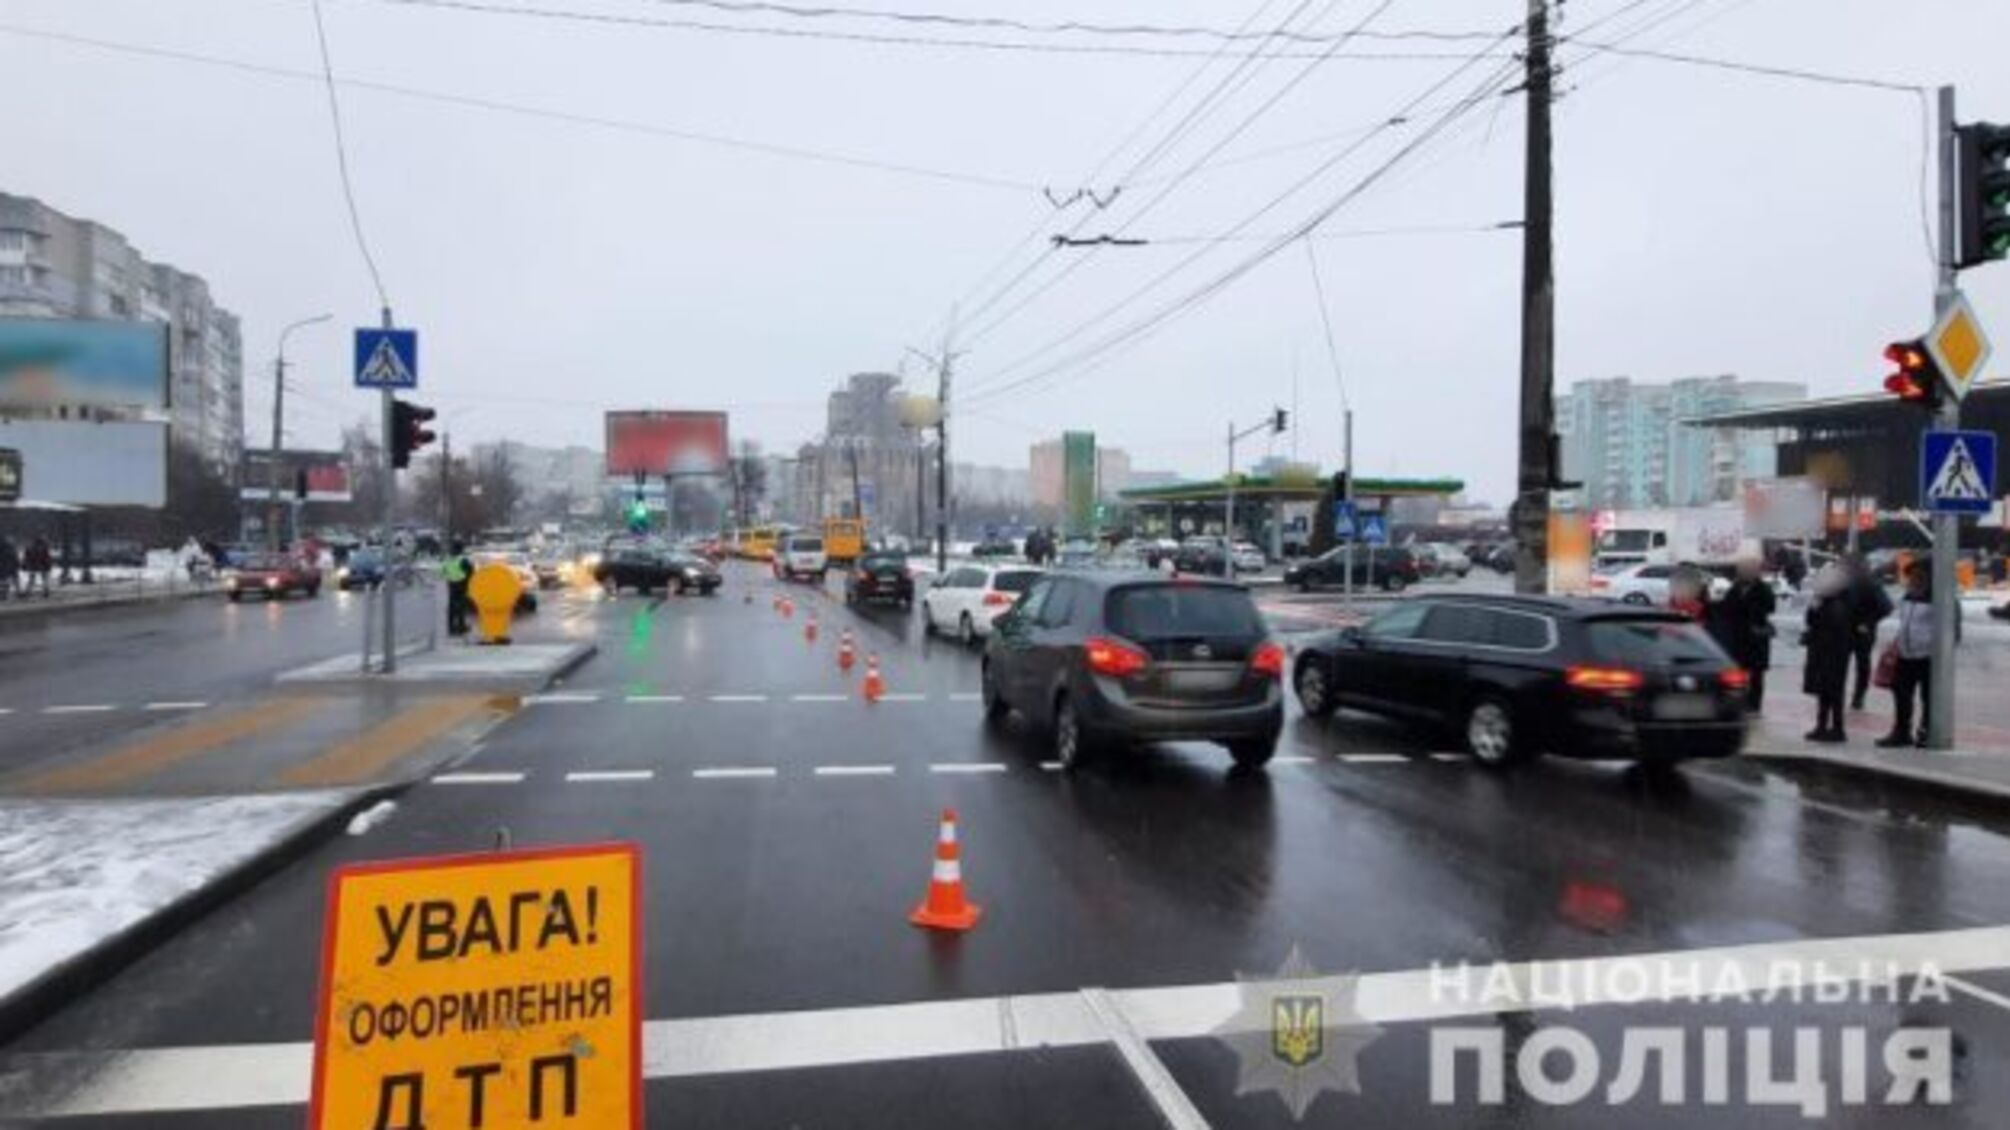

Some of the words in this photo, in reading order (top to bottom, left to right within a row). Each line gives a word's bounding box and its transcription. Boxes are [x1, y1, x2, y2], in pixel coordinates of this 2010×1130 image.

[375, 885, 598, 967] УВАГА!
[349, 976, 612, 1045] ОФОРМЛЕННЯ
[373, 1053, 577, 1130] ДТП
